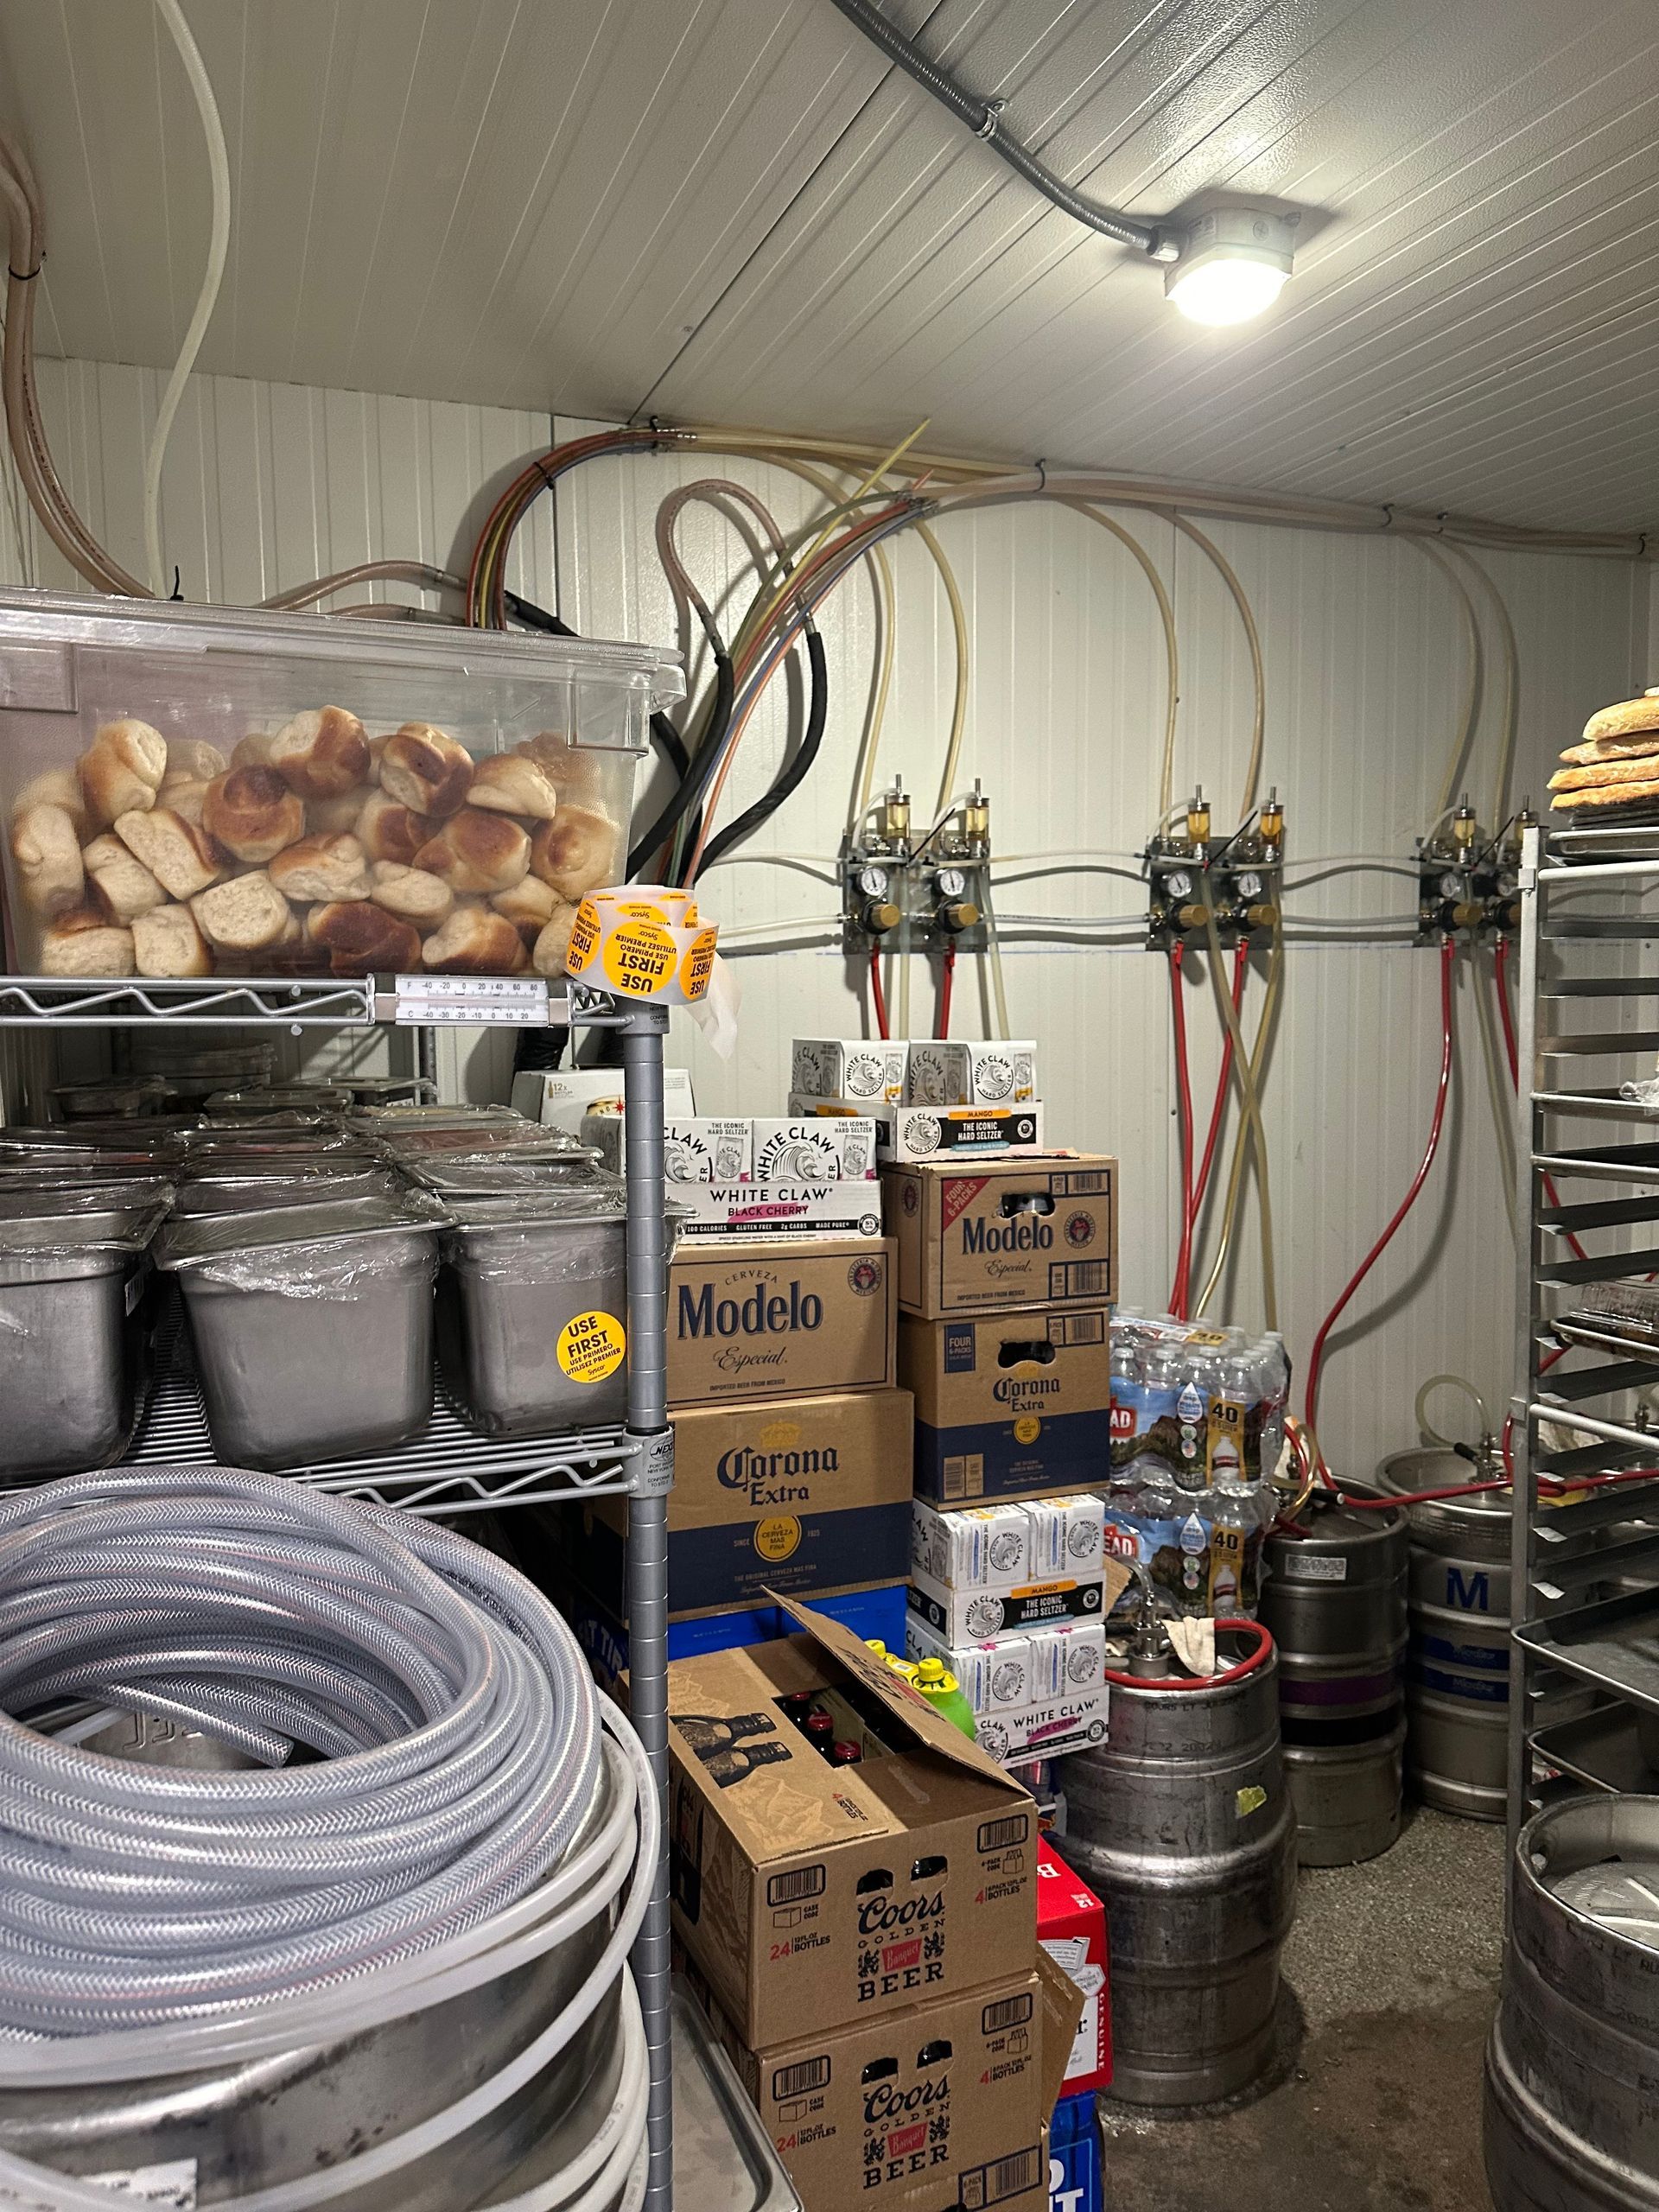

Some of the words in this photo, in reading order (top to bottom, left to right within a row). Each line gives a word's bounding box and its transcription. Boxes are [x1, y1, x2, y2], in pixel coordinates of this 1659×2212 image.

[571, 931, 592, 954] FIRST
[615, 933, 648, 949] PREMIER
[620, 944, 654, 958] PRIMERO
[647, 941, 677, 954] UTILISEZ
[569, 950, 583, 971] USE
[618, 953, 664, 975] FIRST
[655, 952, 669, 961] USE
[690, 959, 710, 977] FIRST
[620, 973, 653, 993] USE
[690, 979, 705, 995] USE
[846, 1056, 860, 1082] WHITE
[861, 1053, 882, 1068] CLAW
[922, 1051, 944, 1077] CLAW
[975, 1058, 987, 1085] WHITE
[988, 1055, 1010, 1069] CLAW
[904, 1116, 917, 1141] WHITE
[918, 1113, 938, 1127] CLAW
[958, 1131, 976, 1141] HARD
[976, 1130, 1002, 1140] SELTZER
[963, 1123, 975, 1132] THE
[976, 1122, 998, 1131] ICONIC
[757, 1132, 786, 1182] WHITE
[788, 1127, 835, 1154] CLAW
[710, 1189, 770, 1203] WHITE
[779, 1188, 828, 1202] CLAW
[945, 1180, 965, 1204] FOUR
[948, 1181, 977, 1217] 6-PACKS
[728, 1206, 762, 1217] BLACK
[766, 1205, 810, 1216] CHERRY
[963, 1216, 1053, 1255] Modelo
[725, 1269, 778, 1286] CERVEZA
[677, 1280, 824, 1340] Modelo
[567, 1316, 598, 1338] USE
[567, 1330, 608, 1358] FIRST
[949, 1337, 971, 1347] FOUR
[566, 1359, 592, 1376] UTILISEZ
[593, 1347, 621, 1363] PREMIER
[569, 1357, 582, 1366] USE
[583, 1344, 613, 1360] PRIMERO
[709, 1382, 736, 1392] IMPORTED
[737, 1382, 750, 1390] BEER
[766, 1379, 786, 1388] MEXICO
[993, 1377, 1061, 1404] Corona
[1012, 1398, 1045, 1413] Extra
[1212, 1402, 1238, 1423] 40
[716, 1446, 840, 1493] Corona
[750, 1481, 810, 1507] Extra
[734, 1539, 750, 1548] SINCE
[761, 1529, 793, 1539] CERVEZA
[1079, 1519, 1098, 1529] WHITE
[1089, 1532, 1100, 1554] CLAW
[1214, 1531, 1238, 1550] 40
[769, 1542, 785, 1551] FINA
[1002, 1532, 1022, 1544] WHITE
[1012, 1543, 1024, 1567] CLAW
[745, 1572, 769, 1581] ORIGINAL
[770, 1568, 793, 1578] CERVEZA
[1032, 1585, 1058, 1594] MANGO
[1446, 1567, 1489, 1611] M
[965, 1600, 980, 1626] WHITE
[980, 1595, 1002, 1609] CLAW
[1026, 1599, 1039, 1609] THE
[1039, 1595, 1063, 1606] ICONIC
[1020, 1609, 1039, 1620] HARD
[1039, 1605, 1067, 1616] SELTZER
[1078, 1644, 1097, 1657] WHITE
[1088, 1656, 1099, 1679] CLAW
[1003, 1661, 1023, 1674] WHITE
[1014, 1674, 1026, 1698] CLAW
[1014, 1709, 1054, 1728] WHITE
[1060, 1699, 1096, 1716] CLAW
[981, 1719, 1006, 1733] CLAW
[1026, 1725, 1050, 1738] BLACK
[974, 1889, 985, 1904] 4
[988, 1885, 1020, 1901] BOTTLES
[804, 1904, 819, 1912] CASE
[804, 1910, 819, 1920] CODE
[857, 1891, 945, 1936] Coors
[858, 1918, 945, 1949] GOLDEN
[770, 1941, 791, 1961] 24
[794, 1935, 830, 1953] BOTTLES
[887, 1942, 919, 1971] Banquet
[858, 1961, 944, 2003] BEER
[980, 2069, 989, 2085] 4
[993, 2064, 1025, 2081] BOTTLES
[863, 2075, 950, 2123] Coors
[864, 2101, 950, 2138] GOLDEN
[777, 2133, 797, 2153] 24
[800, 2126, 836, 2145] BOTTLES
[892, 2125, 925, 2156] Banquet
[863, 2144, 950, 2190] BEER
